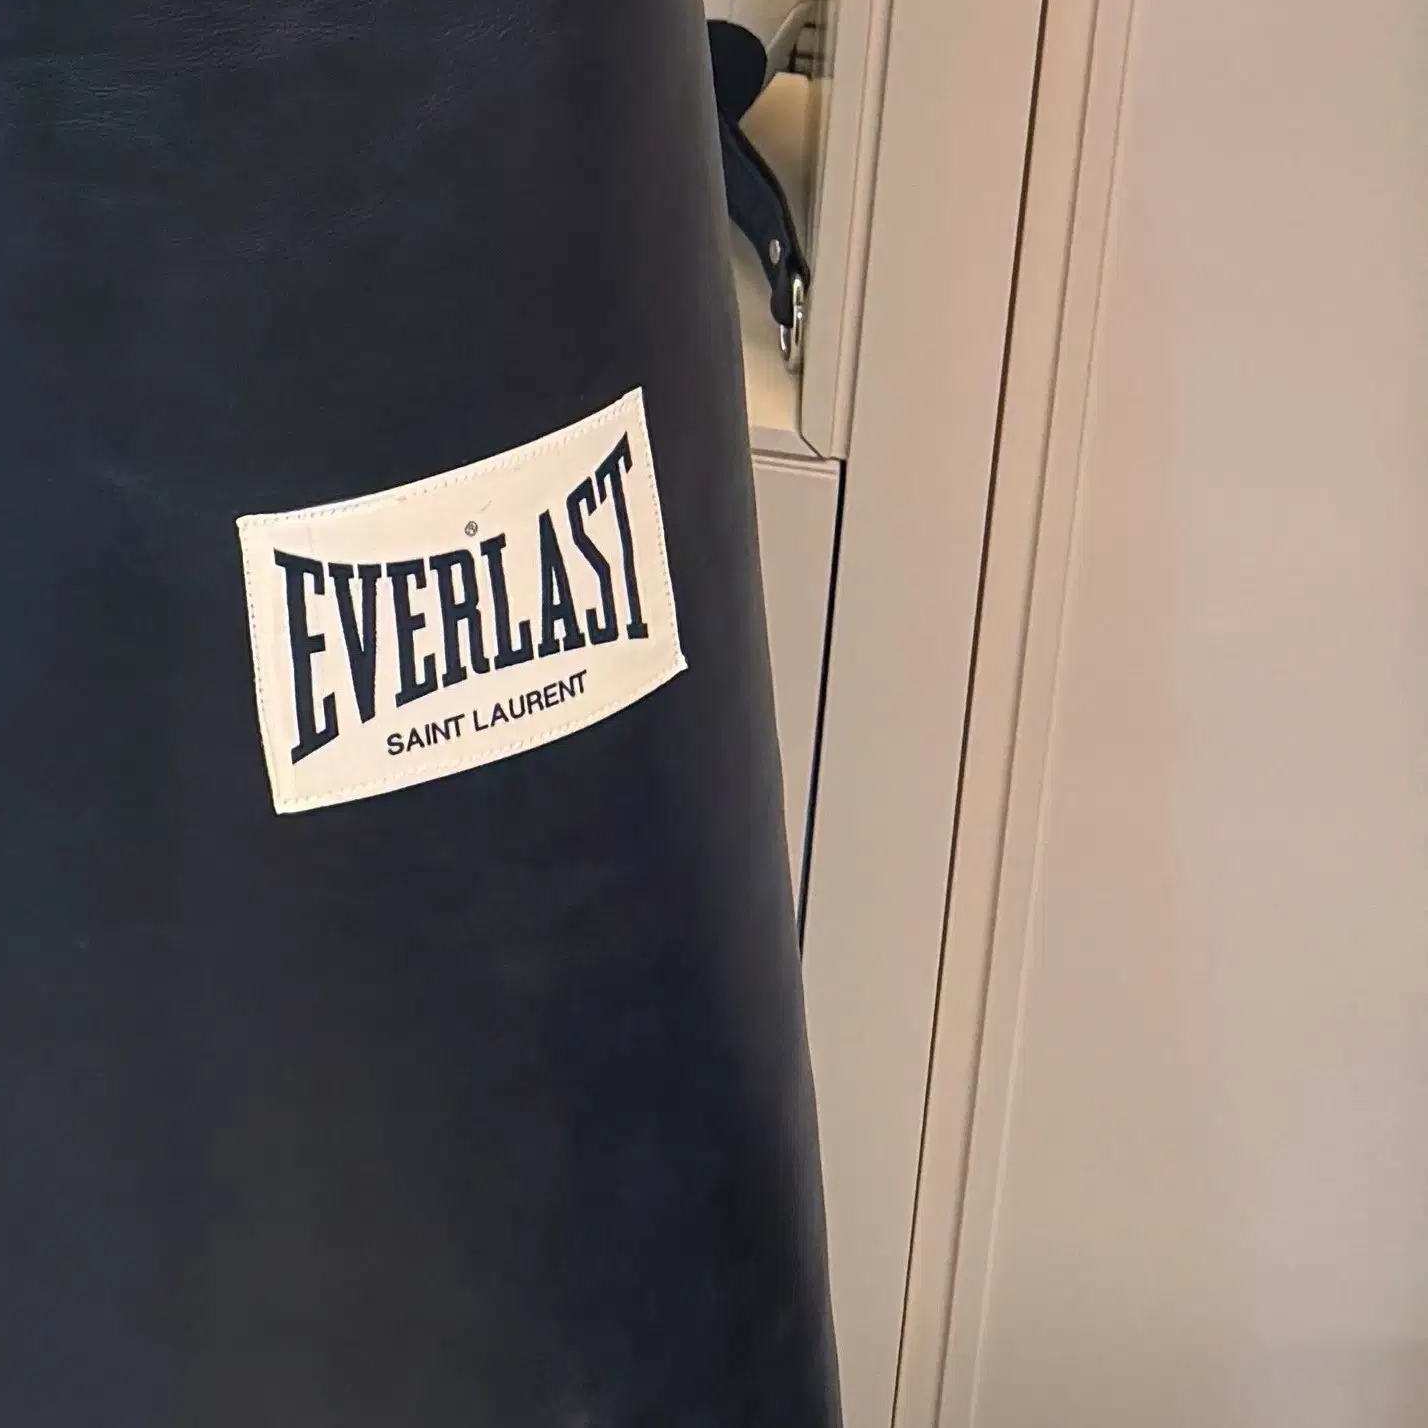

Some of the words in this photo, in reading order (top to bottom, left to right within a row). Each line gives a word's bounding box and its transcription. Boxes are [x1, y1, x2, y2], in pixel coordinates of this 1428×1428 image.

[273, 431, 649, 765] EVERLAST
[386, 713, 465, 756] SAINT
[473, 669, 587, 732] LAURENT
